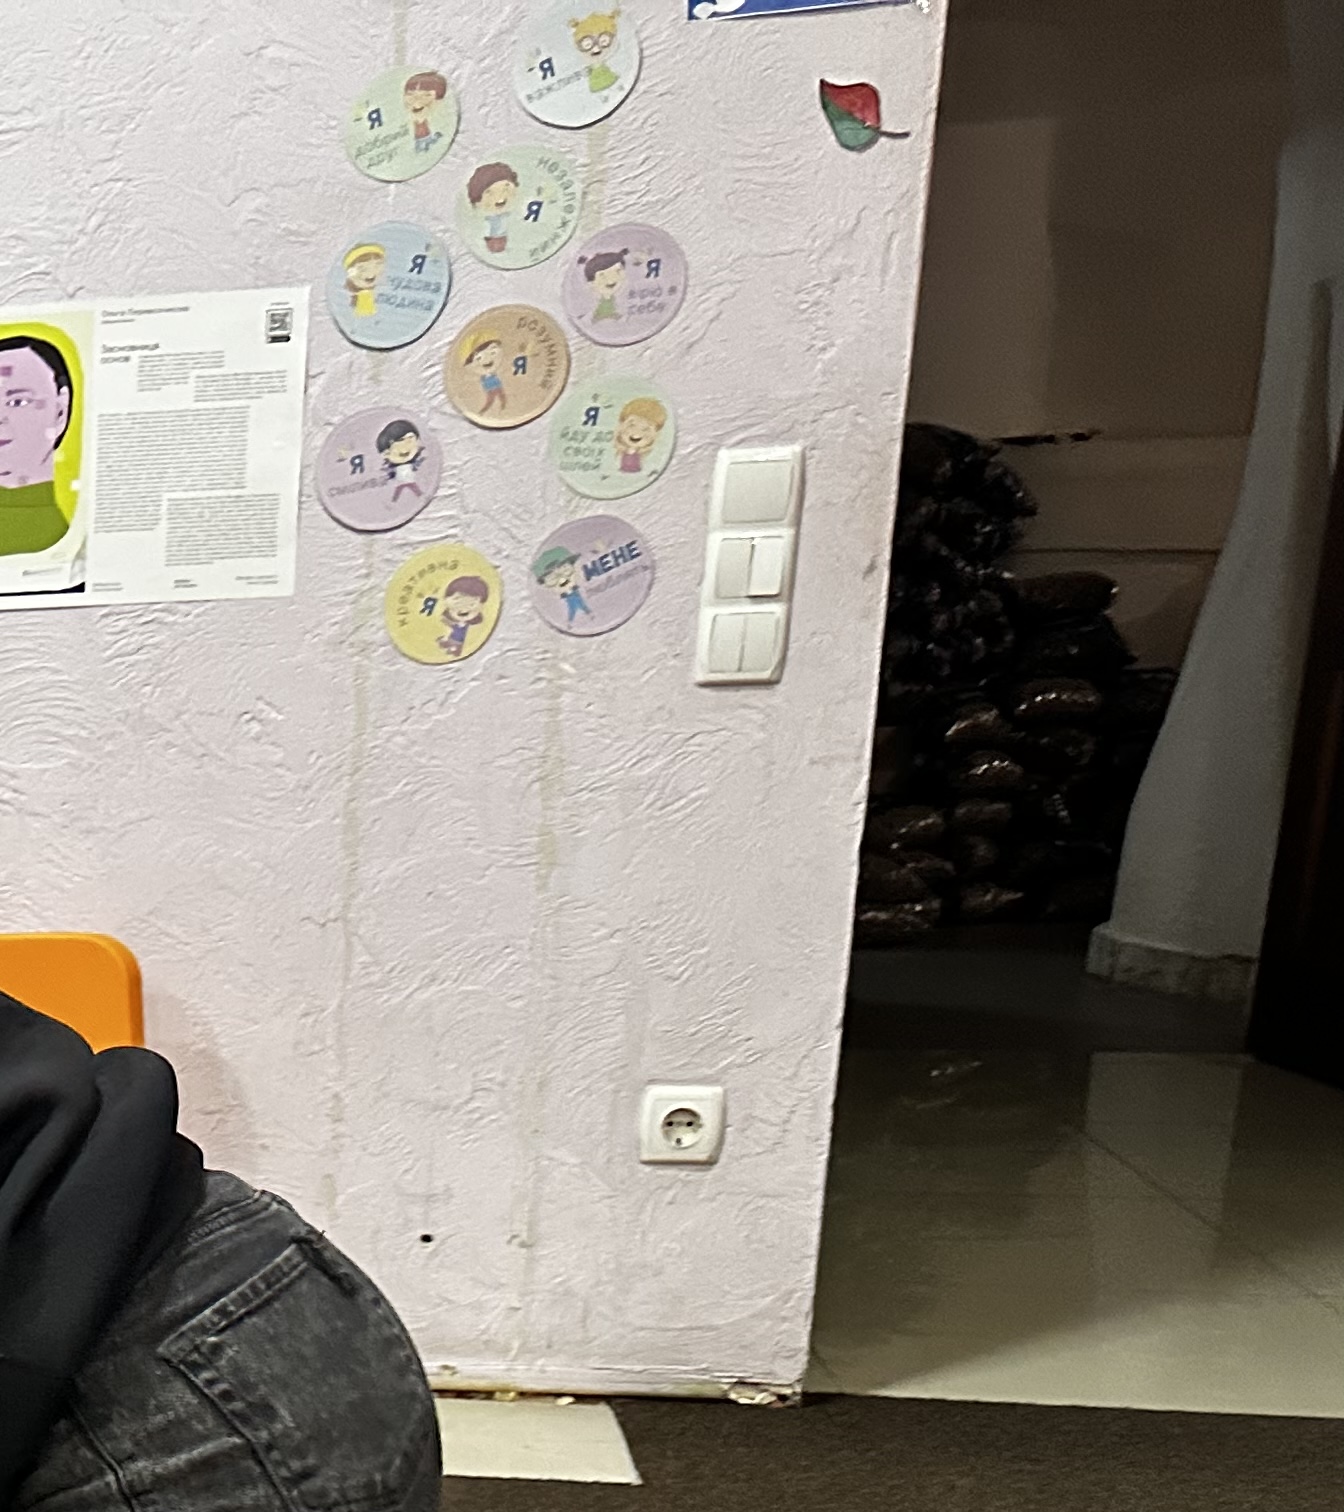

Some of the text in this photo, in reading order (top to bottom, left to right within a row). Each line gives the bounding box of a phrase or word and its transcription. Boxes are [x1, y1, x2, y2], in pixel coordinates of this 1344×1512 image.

[538, 57, 555, 80] Я
[367, 107, 383, 130] Я
[524, 200, 544, 222] Я
[408, 254, 427, 275] Я
[645, 258, 662, 279] Я
[512, 355, 528, 377] Я
[582, 406, 601, 427] Я
[350, 454, 365, 475] Я
[582, 539, 643, 582] МЕНЕ
[419, 597, 439, 617] Я
